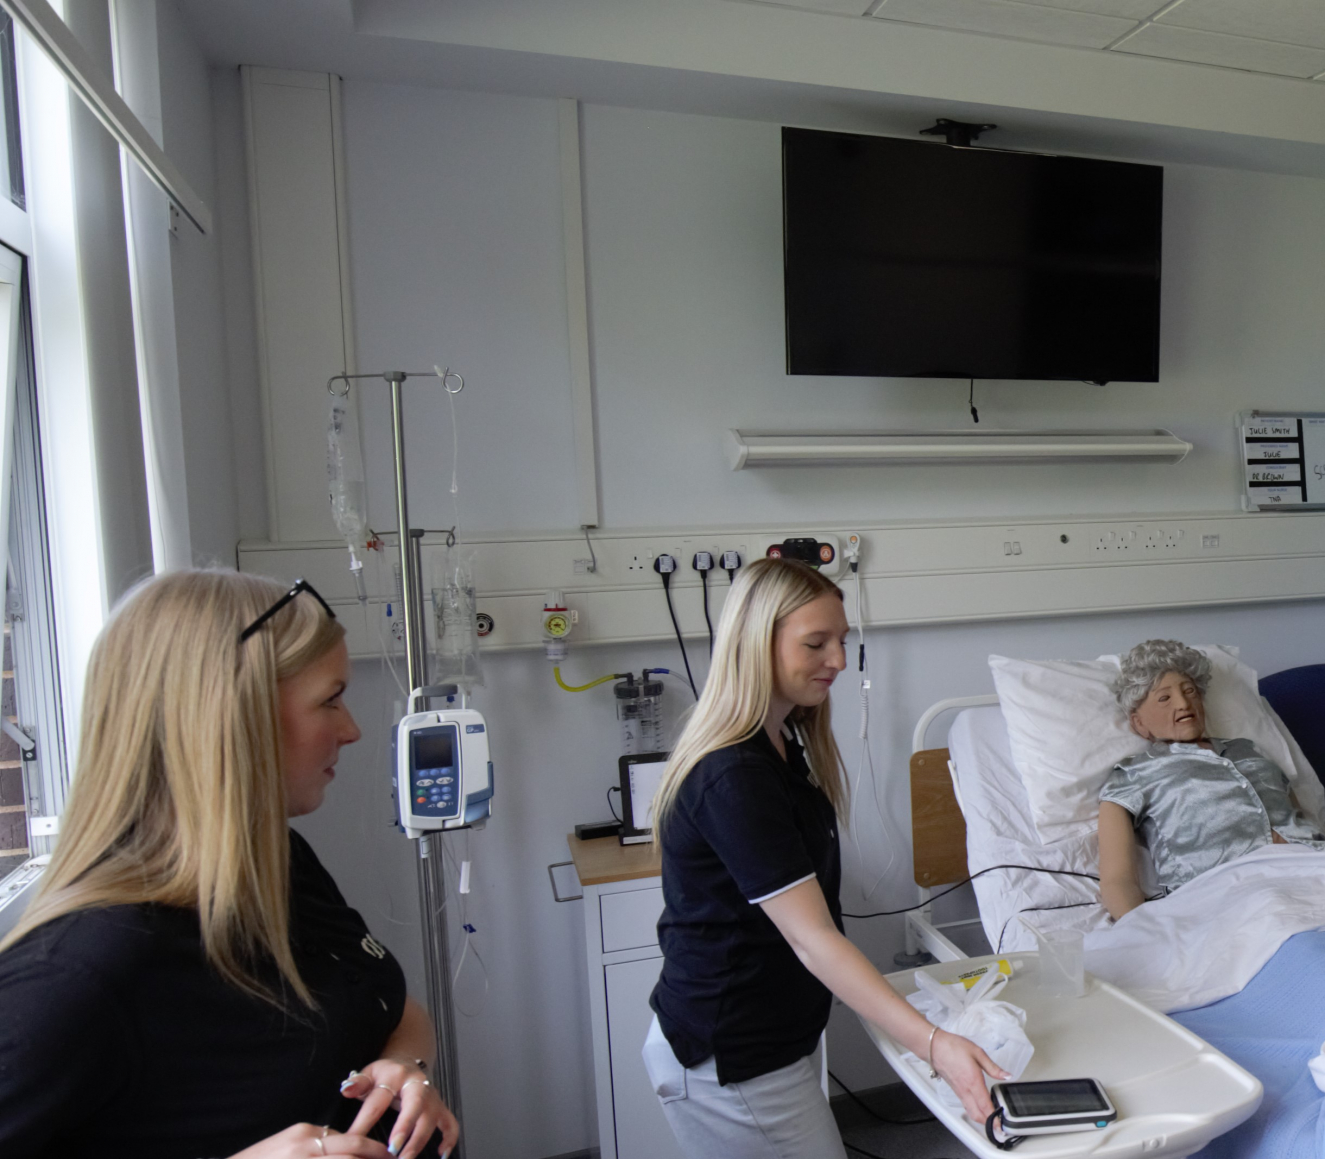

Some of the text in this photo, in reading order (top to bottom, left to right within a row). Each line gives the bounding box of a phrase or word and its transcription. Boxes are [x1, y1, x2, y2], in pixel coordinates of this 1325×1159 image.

[1249, 427, 1291, 436] JULIE SMITH
[1263, 450, 1282, 458] JULIE
[1261, 472, 1285, 482] BROWN
